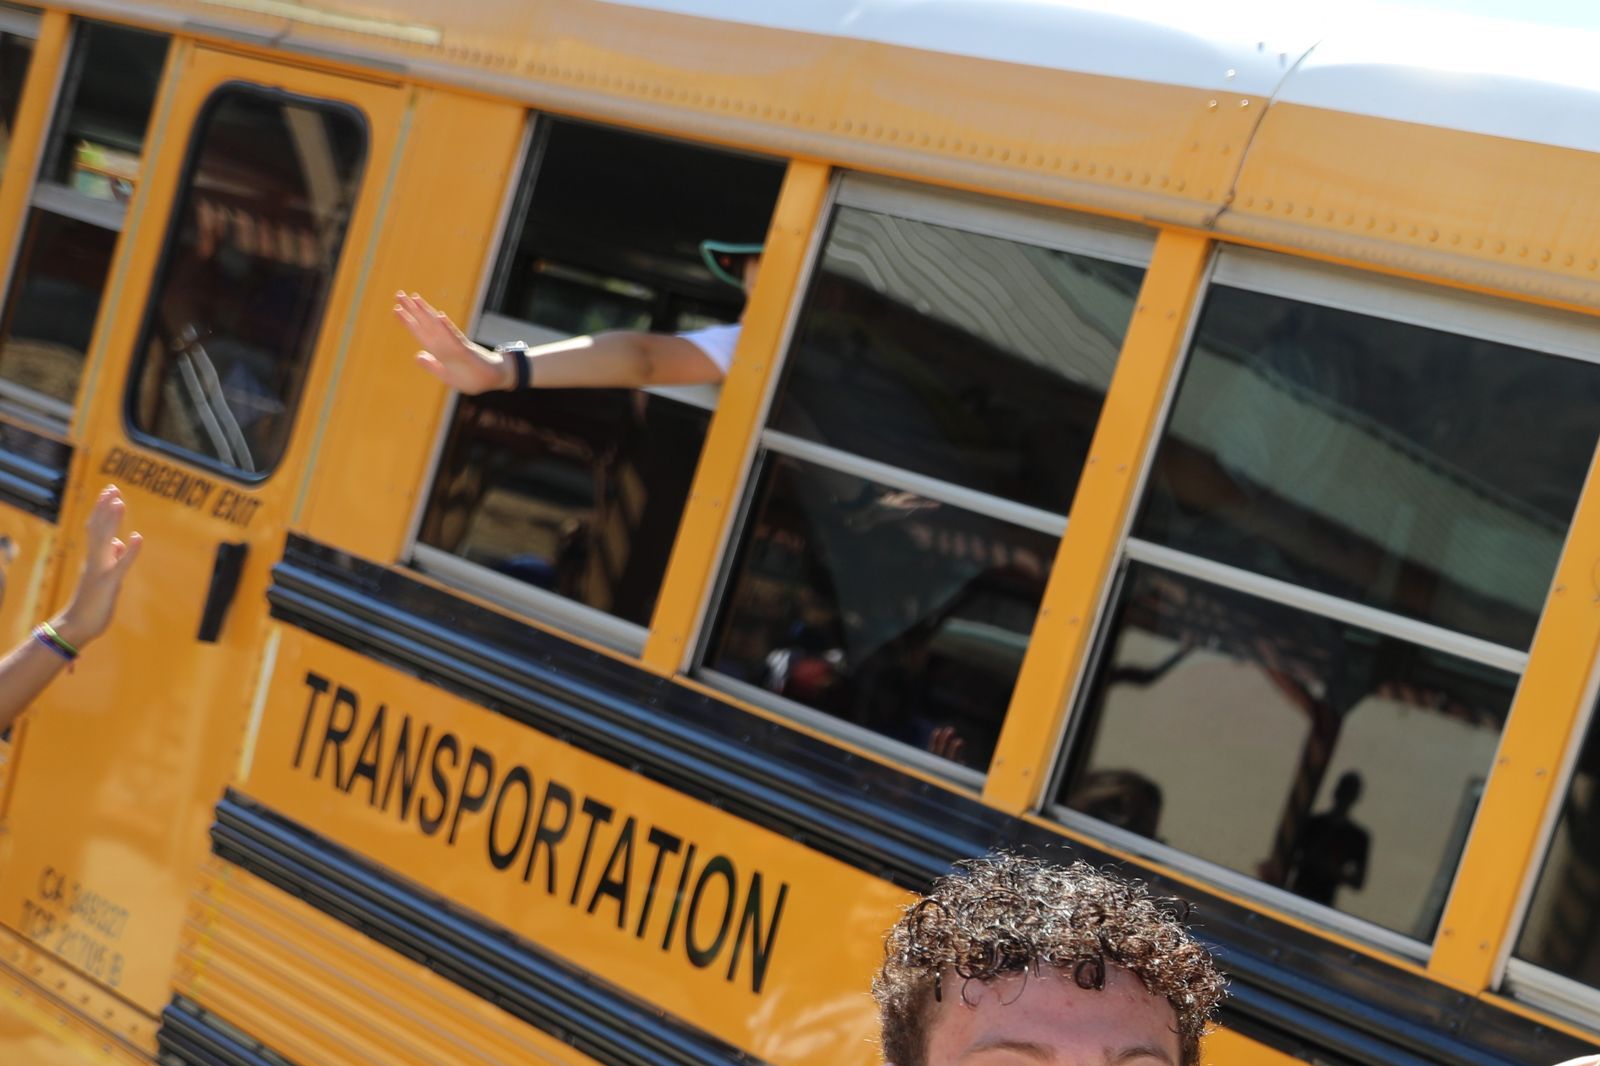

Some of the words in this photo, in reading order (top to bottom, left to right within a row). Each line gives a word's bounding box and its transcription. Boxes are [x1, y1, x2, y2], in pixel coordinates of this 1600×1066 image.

[100, 448, 213, 510] EMERGENCY
[212, 488, 263, 527] EXIT
[291, 670, 790, 995] TRANSPORTATION
